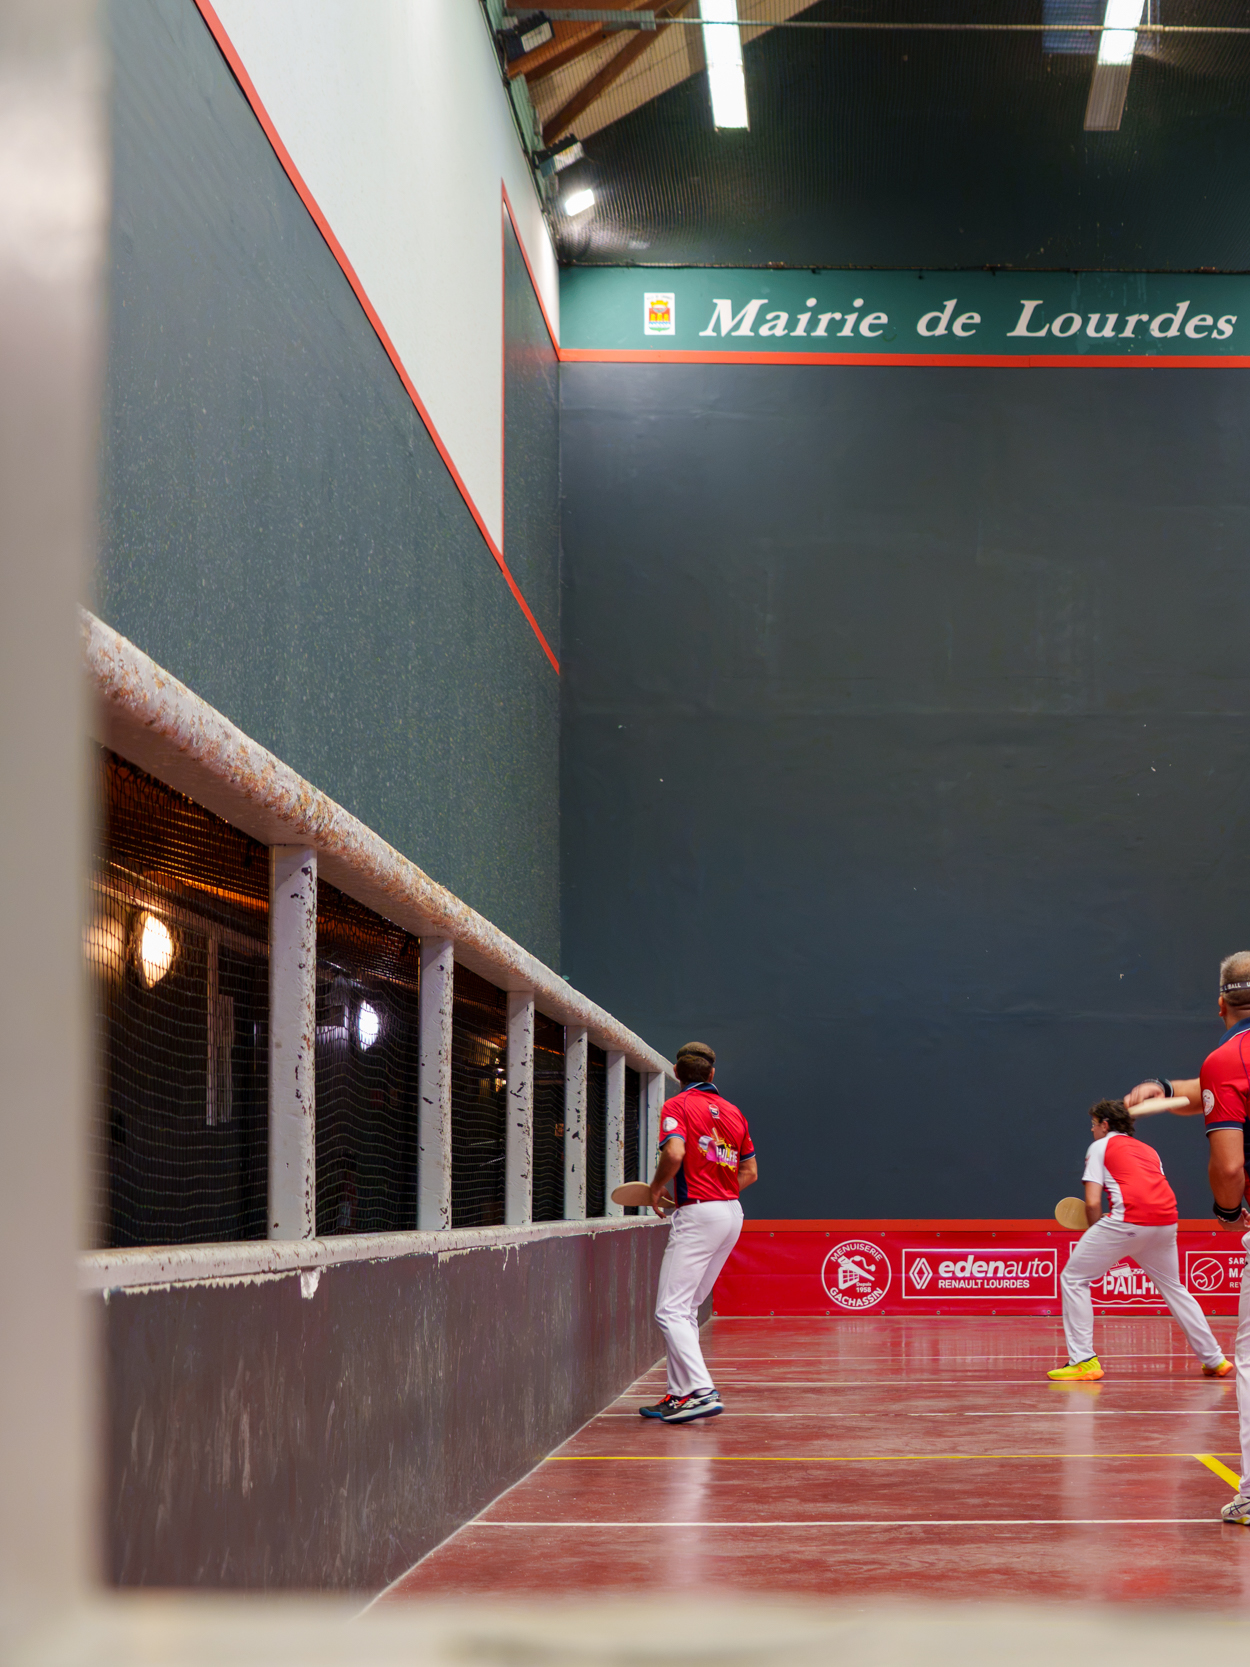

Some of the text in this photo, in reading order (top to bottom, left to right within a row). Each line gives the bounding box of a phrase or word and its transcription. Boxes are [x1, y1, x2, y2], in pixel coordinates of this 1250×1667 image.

[699, 297, 1238, 340] Mairie de Lourdes
[830, 1243, 883, 1262] MENUISERIE
[1228, 1257, 1246, 1265] SAR
[938, 1255, 1054, 1278] edenauto
[938, 1279, 1030, 1289] RENAULT LOURDES
[1103, 1275, 1161, 1295] PAILH
[829, 1286, 883, 1307] GACHASSIN
